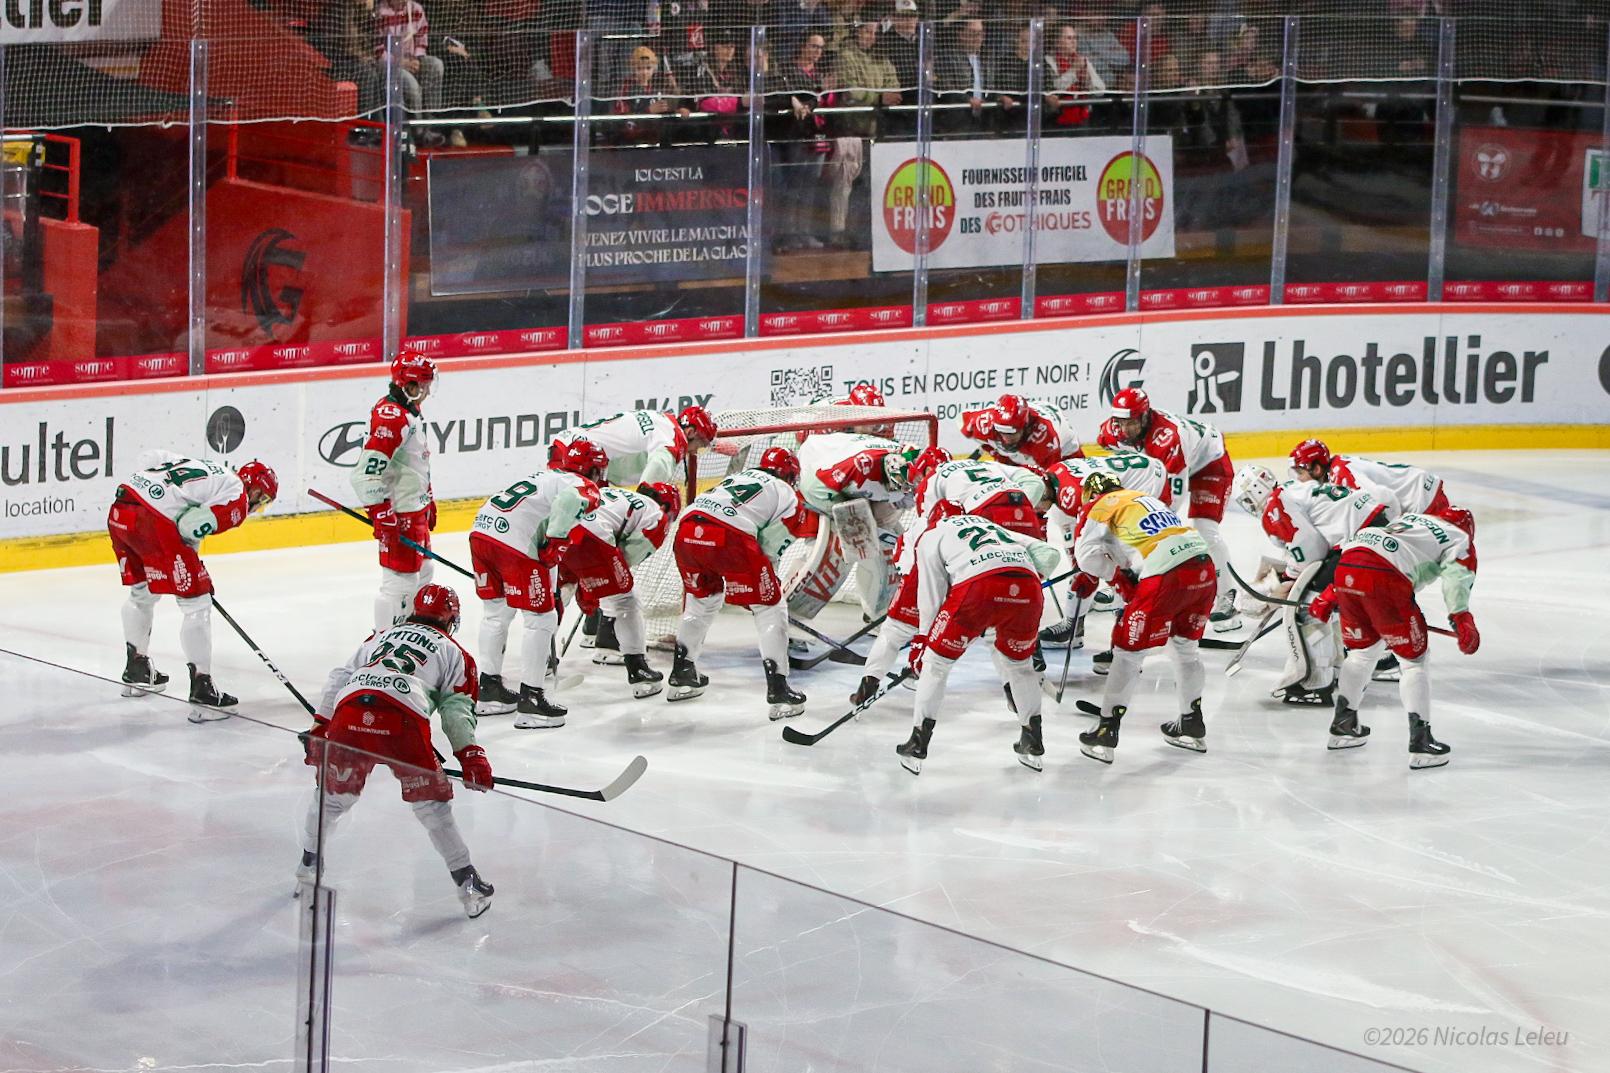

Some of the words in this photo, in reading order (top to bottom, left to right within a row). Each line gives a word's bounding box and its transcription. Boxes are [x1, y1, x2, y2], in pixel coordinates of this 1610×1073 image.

[1041, 165, 1088, 182] OFFICIEL
[580, 193, 634, 216] OGE
[974, 191, 996, 208] DES
[1040, 188, 1071, 205] FRAIS
[893, 206, 946, 230] FRIS
[960, 217, 982, 234] DES
[628, 229, 670, 245] VIVRE
[671, 228, 687, 243] LE
[689, 225, 737, 242] MATCH
[615, 249, 671, 265] PROCHE
[673, 248, 692, 263] DE
[692, 246, 710, 261] LA
[711, 244, 752, 260] GLAC
[902, 375, 927, 395] EN
[934, 369, 997, 392] ROUGE
[1004, 366, 1029, 387] ET
[1036, 364, 1082, 385] NOIR
[1260, 334, 1549, 411] Lhotellier
[1049, 394, 1089, 411] IGNE
[422, 411, 580, 456] YUNDAI
[1, 416, 114, 486] ultel
[5, 495, 75, 518] location
[490, 480, 538, 513] 9
